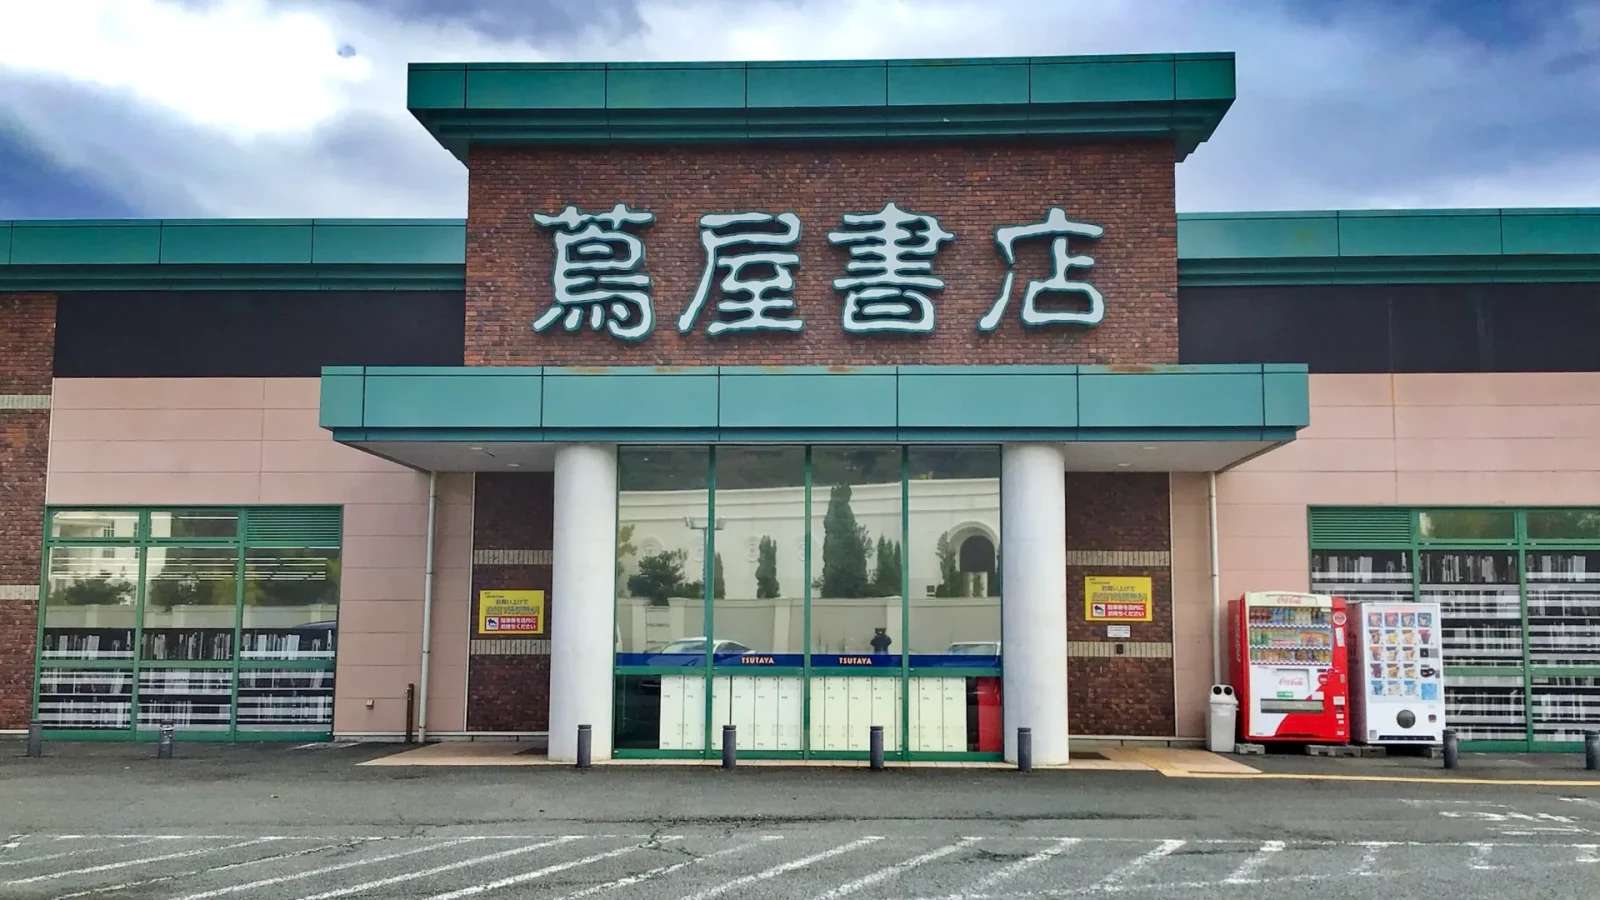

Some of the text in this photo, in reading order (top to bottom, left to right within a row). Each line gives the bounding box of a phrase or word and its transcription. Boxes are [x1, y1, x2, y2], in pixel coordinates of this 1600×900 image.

[532, 202, 1106, 340] 蔦屋書店
[1277, 596, 1301, 605] Coca-Cola
[741, 656, 775, 664] TSUTAYA
[838, 657, 872, 665] TSUTAYA
[1279, 676, 1303, 686] Coca-Cola
